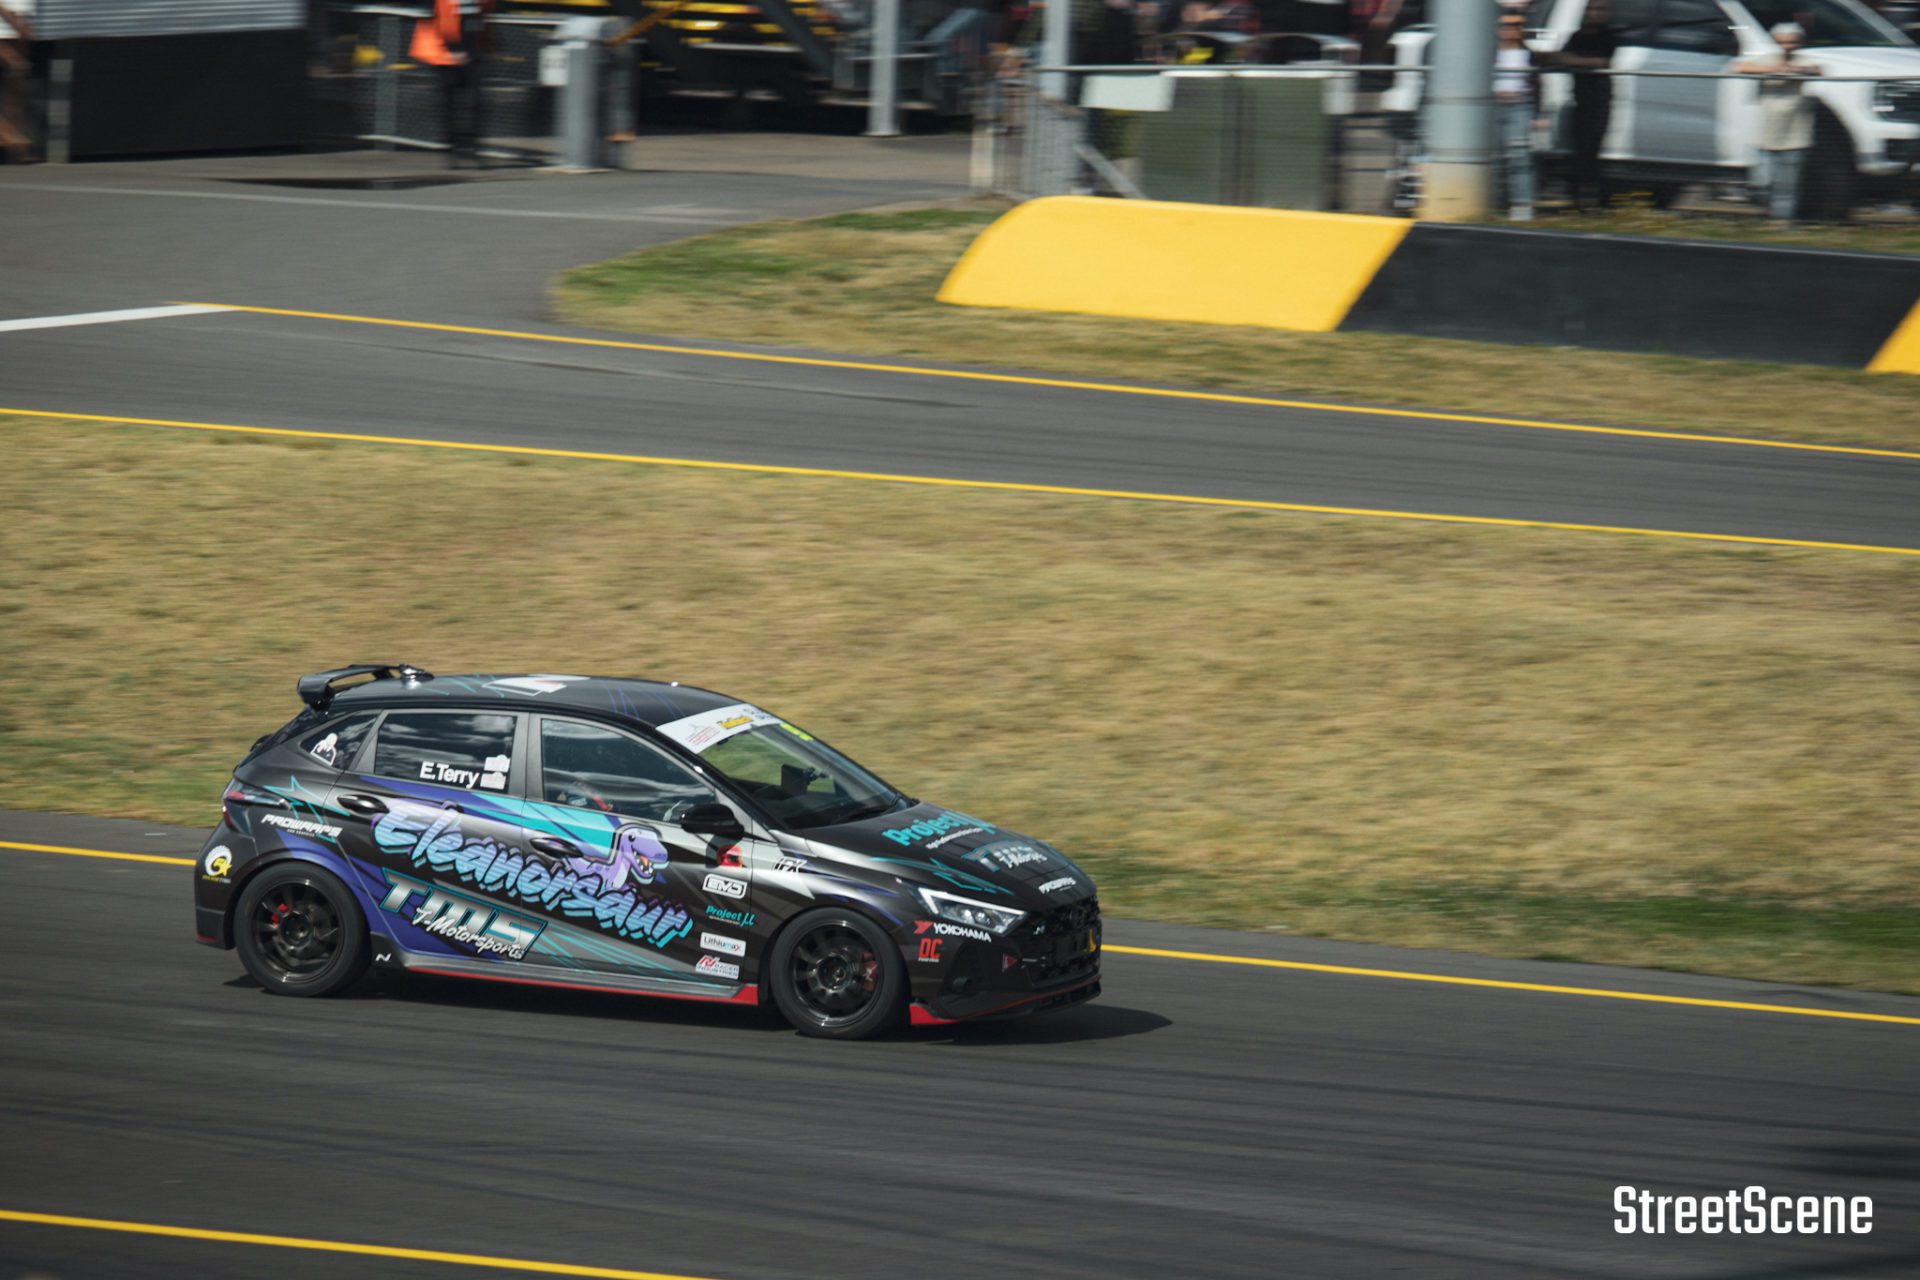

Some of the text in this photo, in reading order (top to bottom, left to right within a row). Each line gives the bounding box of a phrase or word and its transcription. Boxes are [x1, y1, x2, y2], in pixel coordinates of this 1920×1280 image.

[261, 814, 343, 837] PROWRAPS
[372, 803, 694, 948] Eleanorsaur
[379, 867, 548, 957] TMS
[706, 905, 743, 921] Project
[411, 907, 525, 959] T-Motorsports
[933, 922, 992, 942] YOKOHAMA
[918, 938, 943, 959] DC
